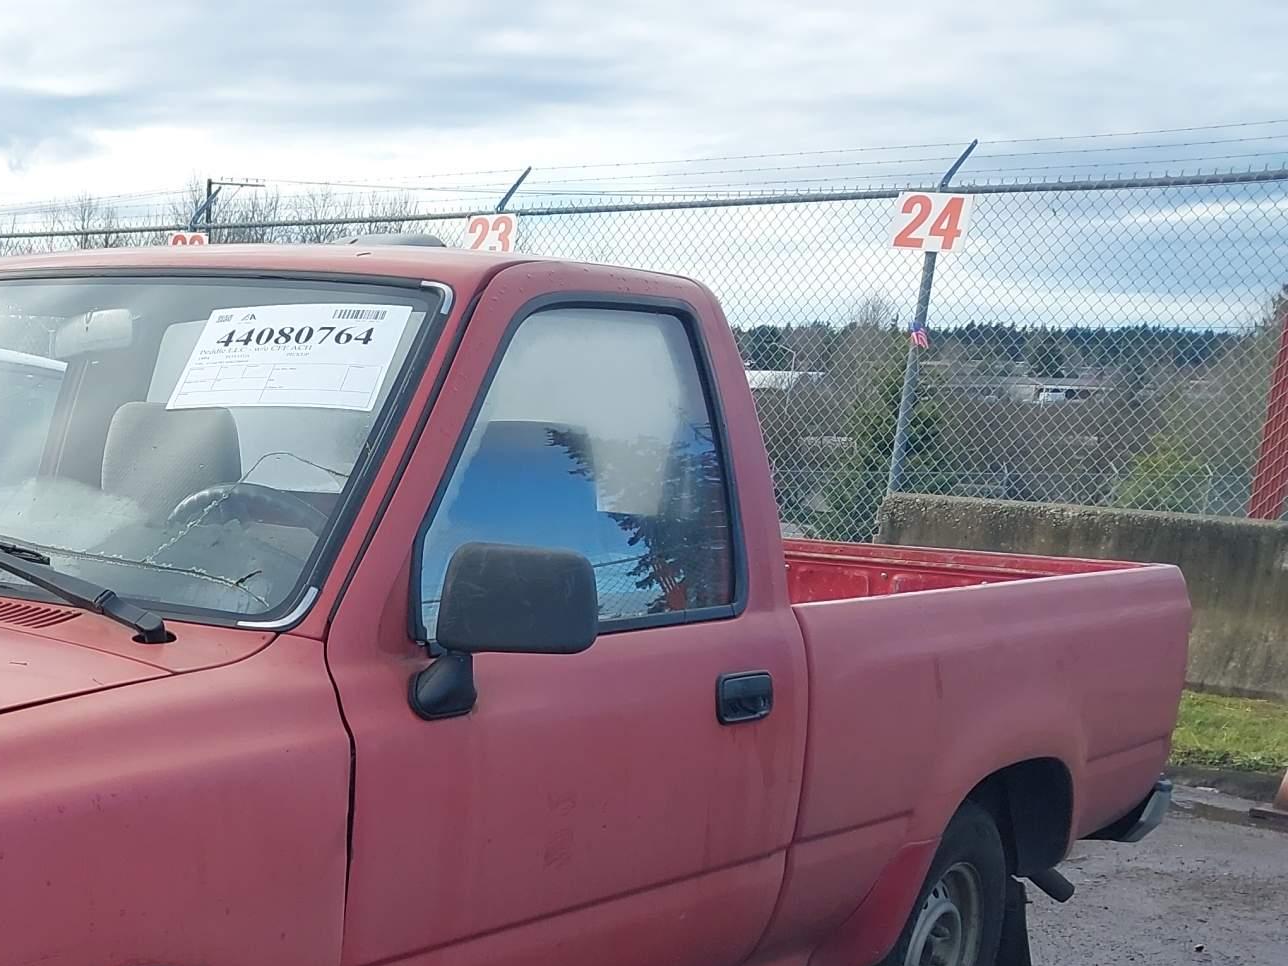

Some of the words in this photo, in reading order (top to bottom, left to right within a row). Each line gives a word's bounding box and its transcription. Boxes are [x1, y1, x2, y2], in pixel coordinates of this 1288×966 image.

[468, 215, 513, 252] 23
[893, 194, 964, 250] 24
[216, 325, 375, 347] 44080764
